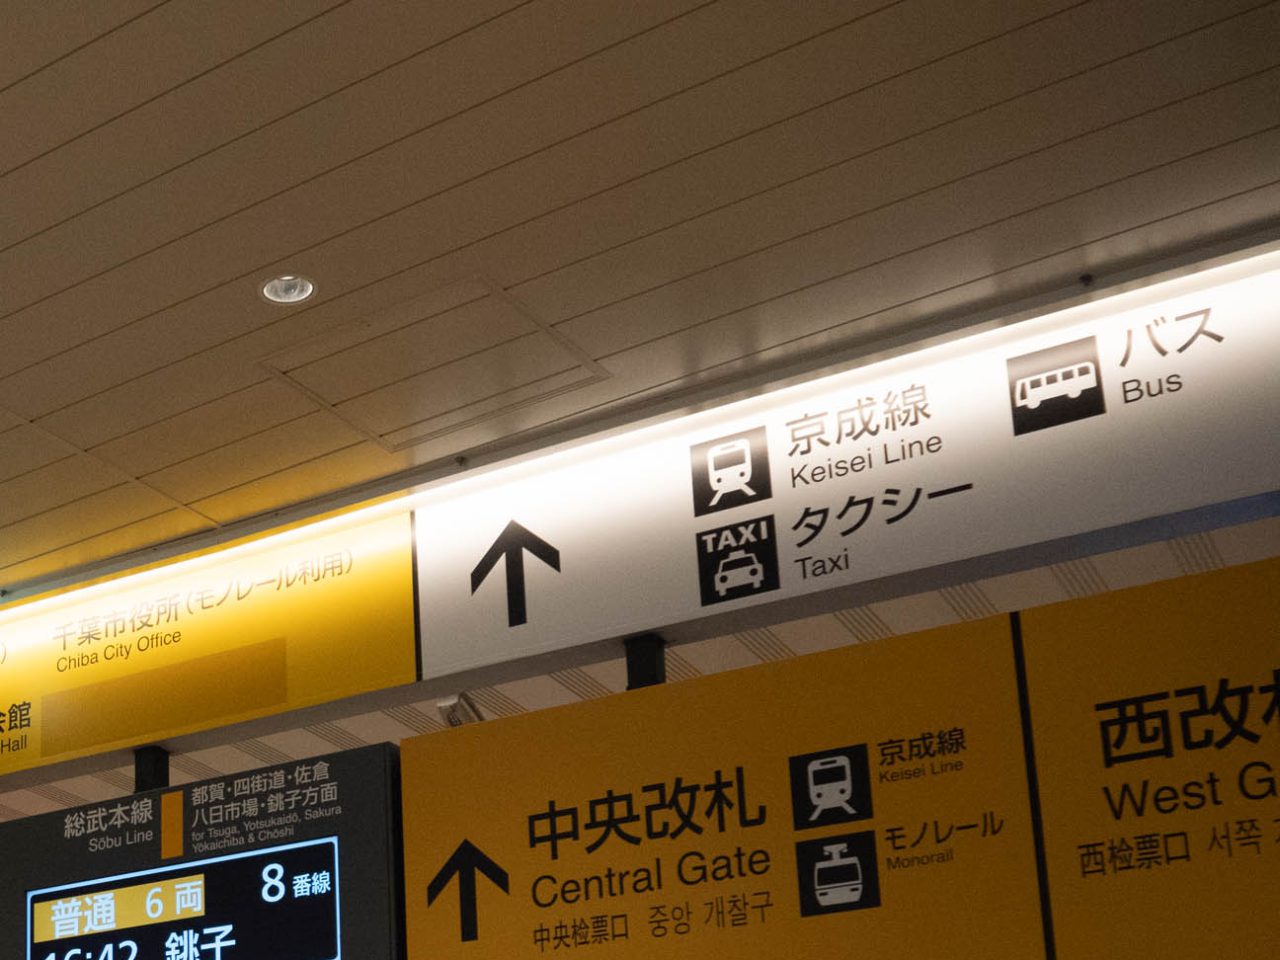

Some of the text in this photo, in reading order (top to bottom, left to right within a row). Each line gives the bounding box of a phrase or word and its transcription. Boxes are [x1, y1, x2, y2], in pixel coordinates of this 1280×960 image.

[1120, 308, 1225, 367] バス
[1122, 371, 1183, 404] Bus
[787, 384, 931, 457] 京成線
[790, 433, 943, 488] Keisei Line
[792, 482, 973, 548] タクシー
[703, 524, 769, 552] TAXI
[795, 549, 850, 580] Taxi
[57, 631, 181, 672] Chiba City Office
[0, 735, 28, 753] Hall
[877, 728, 966, 767] 京成線
[879, 758, 964, 784] Keisei Line
[528, 767, 766, 860] 中央改札
[1102, 772, 1223, 820] West
[64, 799, 153, 838] 総武本線
[126, 829, 153, 847] Line
[192, 829, 205, 841] for
[305, 805, 342, 821] Sakura
[885, 811, 1004, 851] モノレール
[247, 834, 255, 845] &
[531, 847, 771, 908] Central Gate
[887, 849, 954, 871] Monorail
[51, 892, 116, 940] 普通
[648, 891, 774, 938] 중앙 개찰구
